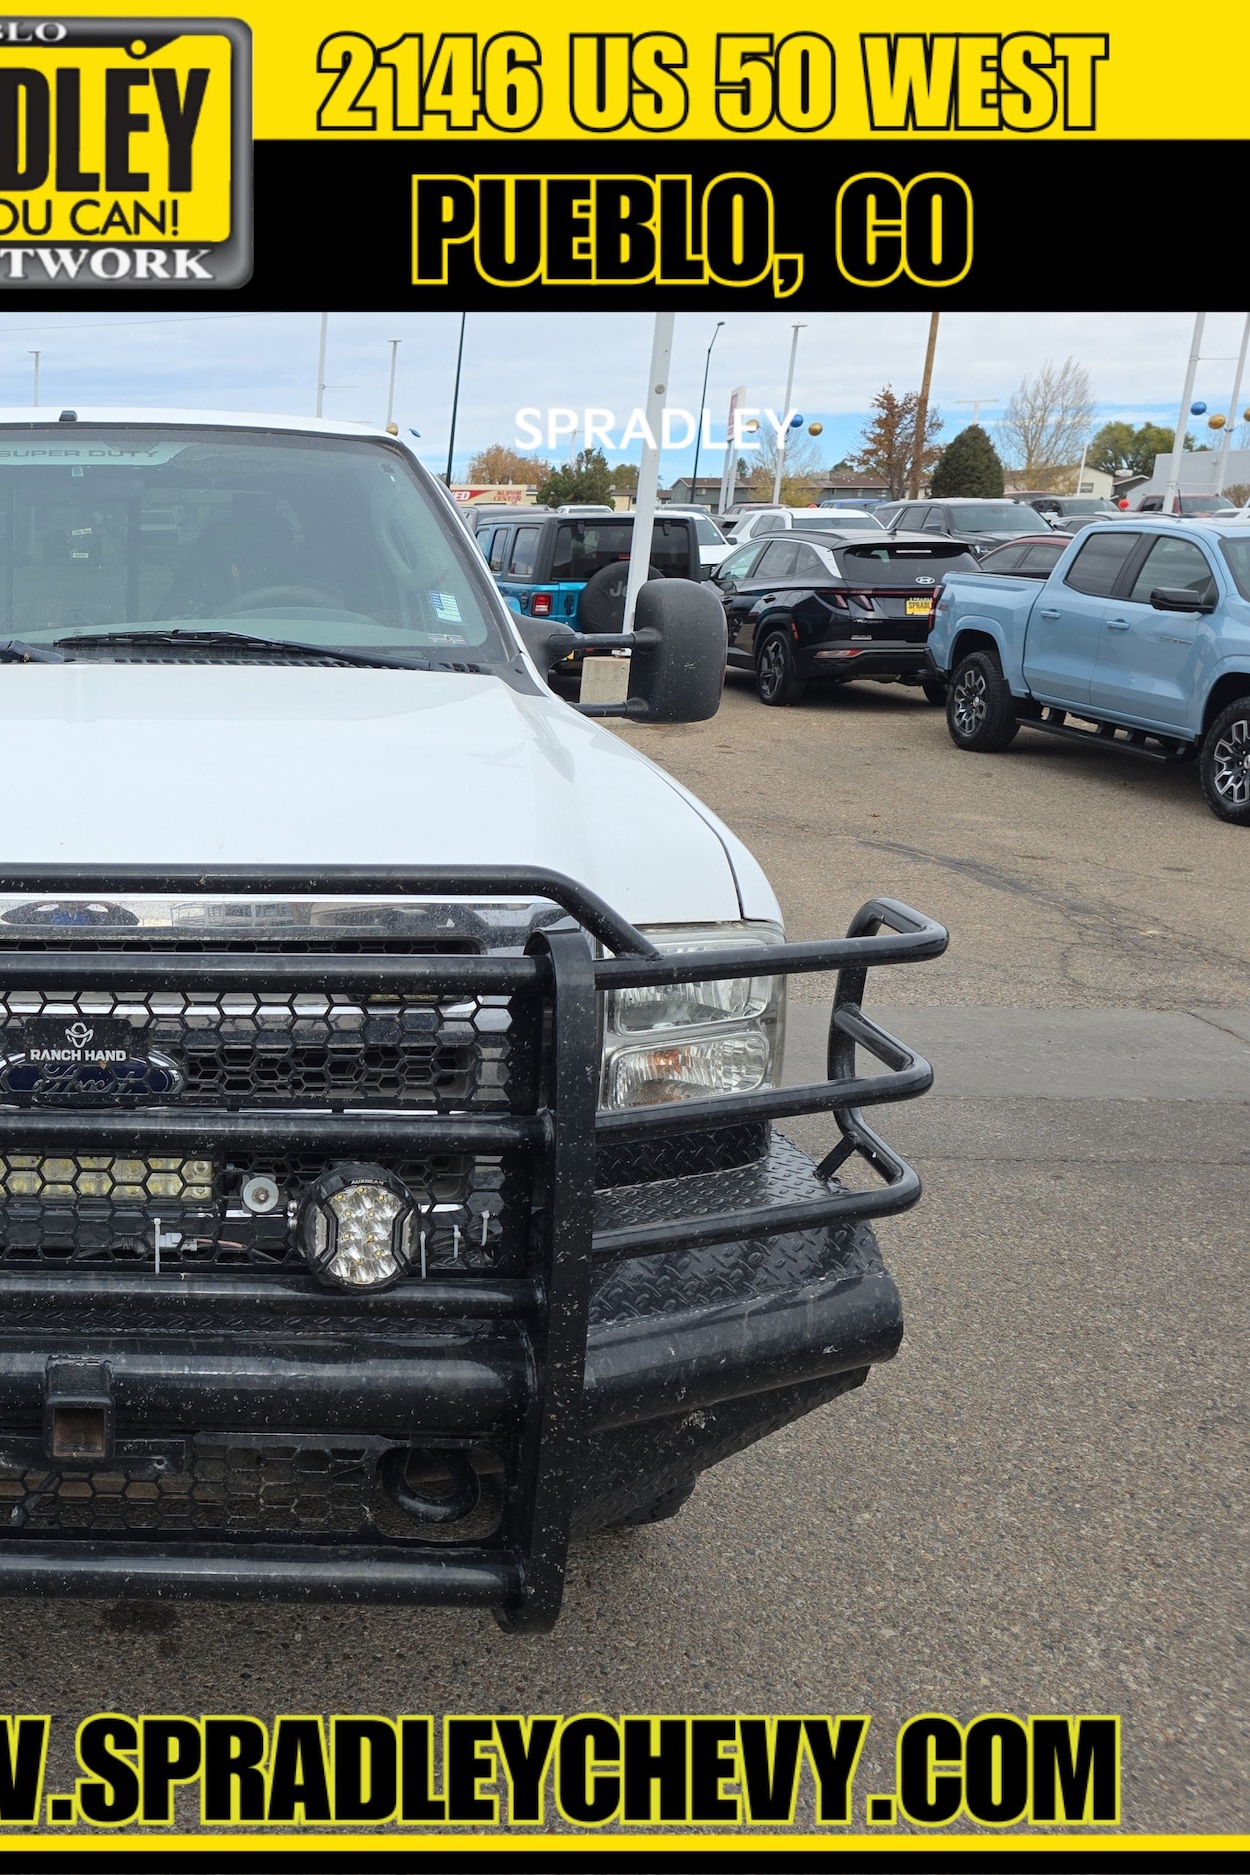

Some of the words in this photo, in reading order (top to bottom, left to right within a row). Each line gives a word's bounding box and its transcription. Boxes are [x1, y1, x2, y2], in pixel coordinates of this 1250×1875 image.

[88, 450, 159, 458] DUTY
[908, 601, 931, 610] SPRADL
[30, 1050, 82, 1062] RANCH
[85, 1050, 127, 1062] HAND
